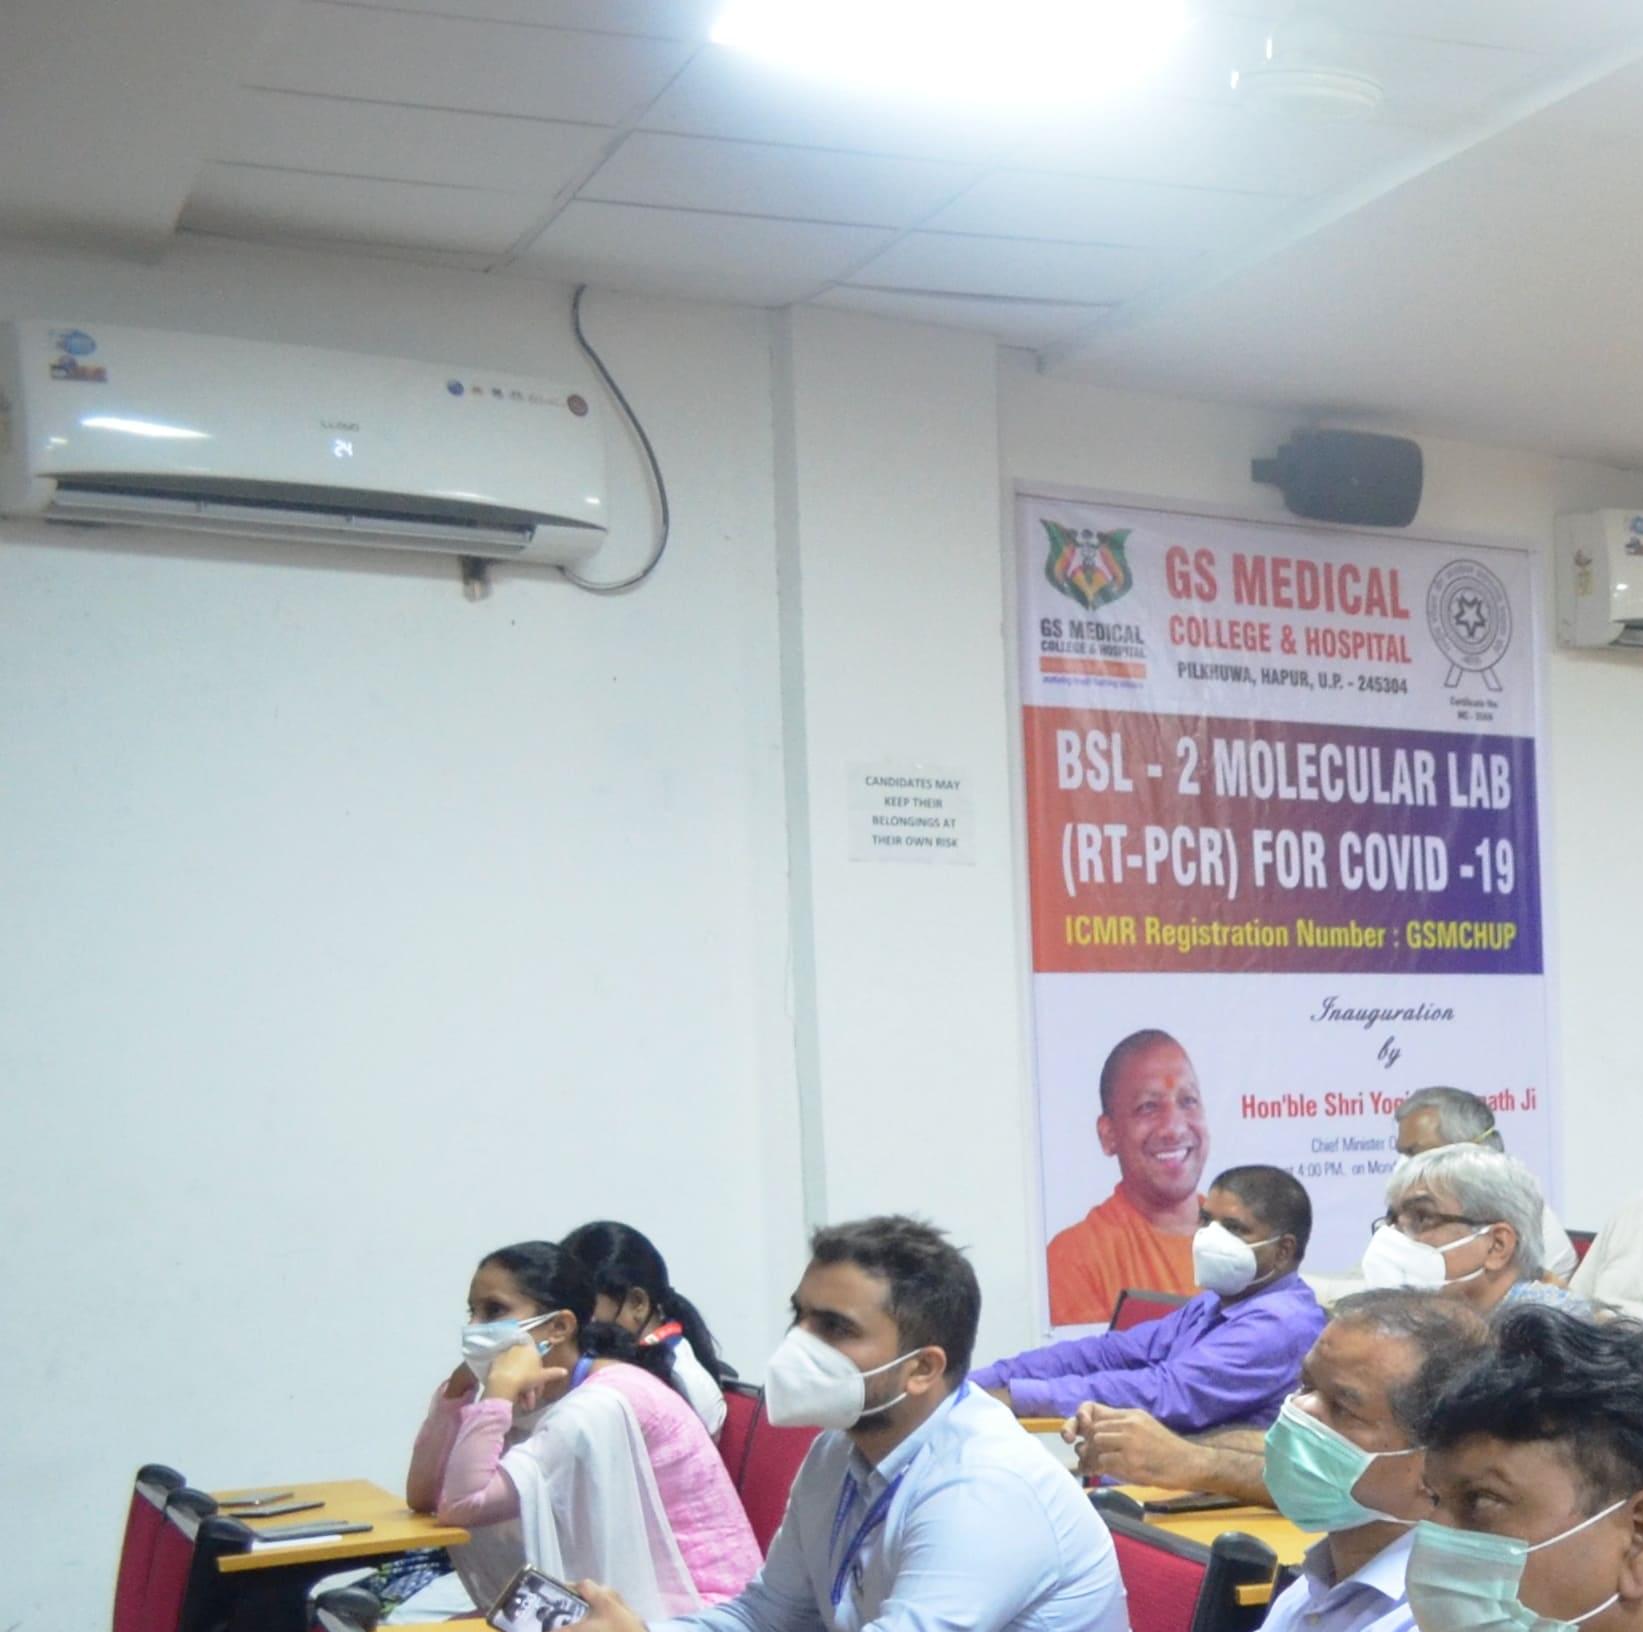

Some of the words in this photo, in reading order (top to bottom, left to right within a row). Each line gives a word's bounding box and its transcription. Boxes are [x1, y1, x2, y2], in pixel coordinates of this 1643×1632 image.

[1165, 545, 1217, 602] GS
[1232, 552, 1411, 620] MEDICAL
[1041, 617, 1063, 638] GS
[1069, 619, 1144, 645] MEDICAL
[1169, 614, 1272, 653] COLLEGE
[1280, 623, 1297, 655] &
[1305, 626, 1413, 664] HOSPITAL
[1261, 668, 1315, 692] HAPUR,
[1318, 671, 1344, 690] U.P.
[1357, 675, 1408, 695] 245304
[865, 776, 932, 790] CANDIDATES
[935, 779, 960, 791] MAY
[1056, 729, 1134, 792] BSL
[1147, 763, 1163, 778] -
[1176, 736, 1200, 795] 2
[1213, 737, 1438, 807] MOLECULAR
[1447, 751, 1512, 810] LAB
[884, 796, 910, 808] KEEP
[913, 797, 943, 809] THEIR
[872, 815, 941, 828] BELONGINGS
[943, 818, 956, 829] AT
[872, 834, 903, 847] THEIR
[905, 835, 933, 848] OWN
[935, 837, 959, 848] RISK
[1062, 823, 1239, 900] (RT-PCR)
[1252, 829, 1328, 889] FOR
[1339, 830, 1448, 891] COVID
[1459, 837, 1515, 894] -19
[1065, 914, 1137, 946] ICMR
[1144, 916, 1288, 953] Registration
[1296, 919, 1386, 948] Number
[1406, 920, 1517, 950] GSMCHUP
[1310, 995, 1455, 1030] Inauguration
[1377, 1035, 1402, 1069] by
[1241, 1092, 1318, 1119] Hon'ble
[1324, 1091, 1364, 1117] Shri
[1521, 1088, 1537, 1111] Ji
